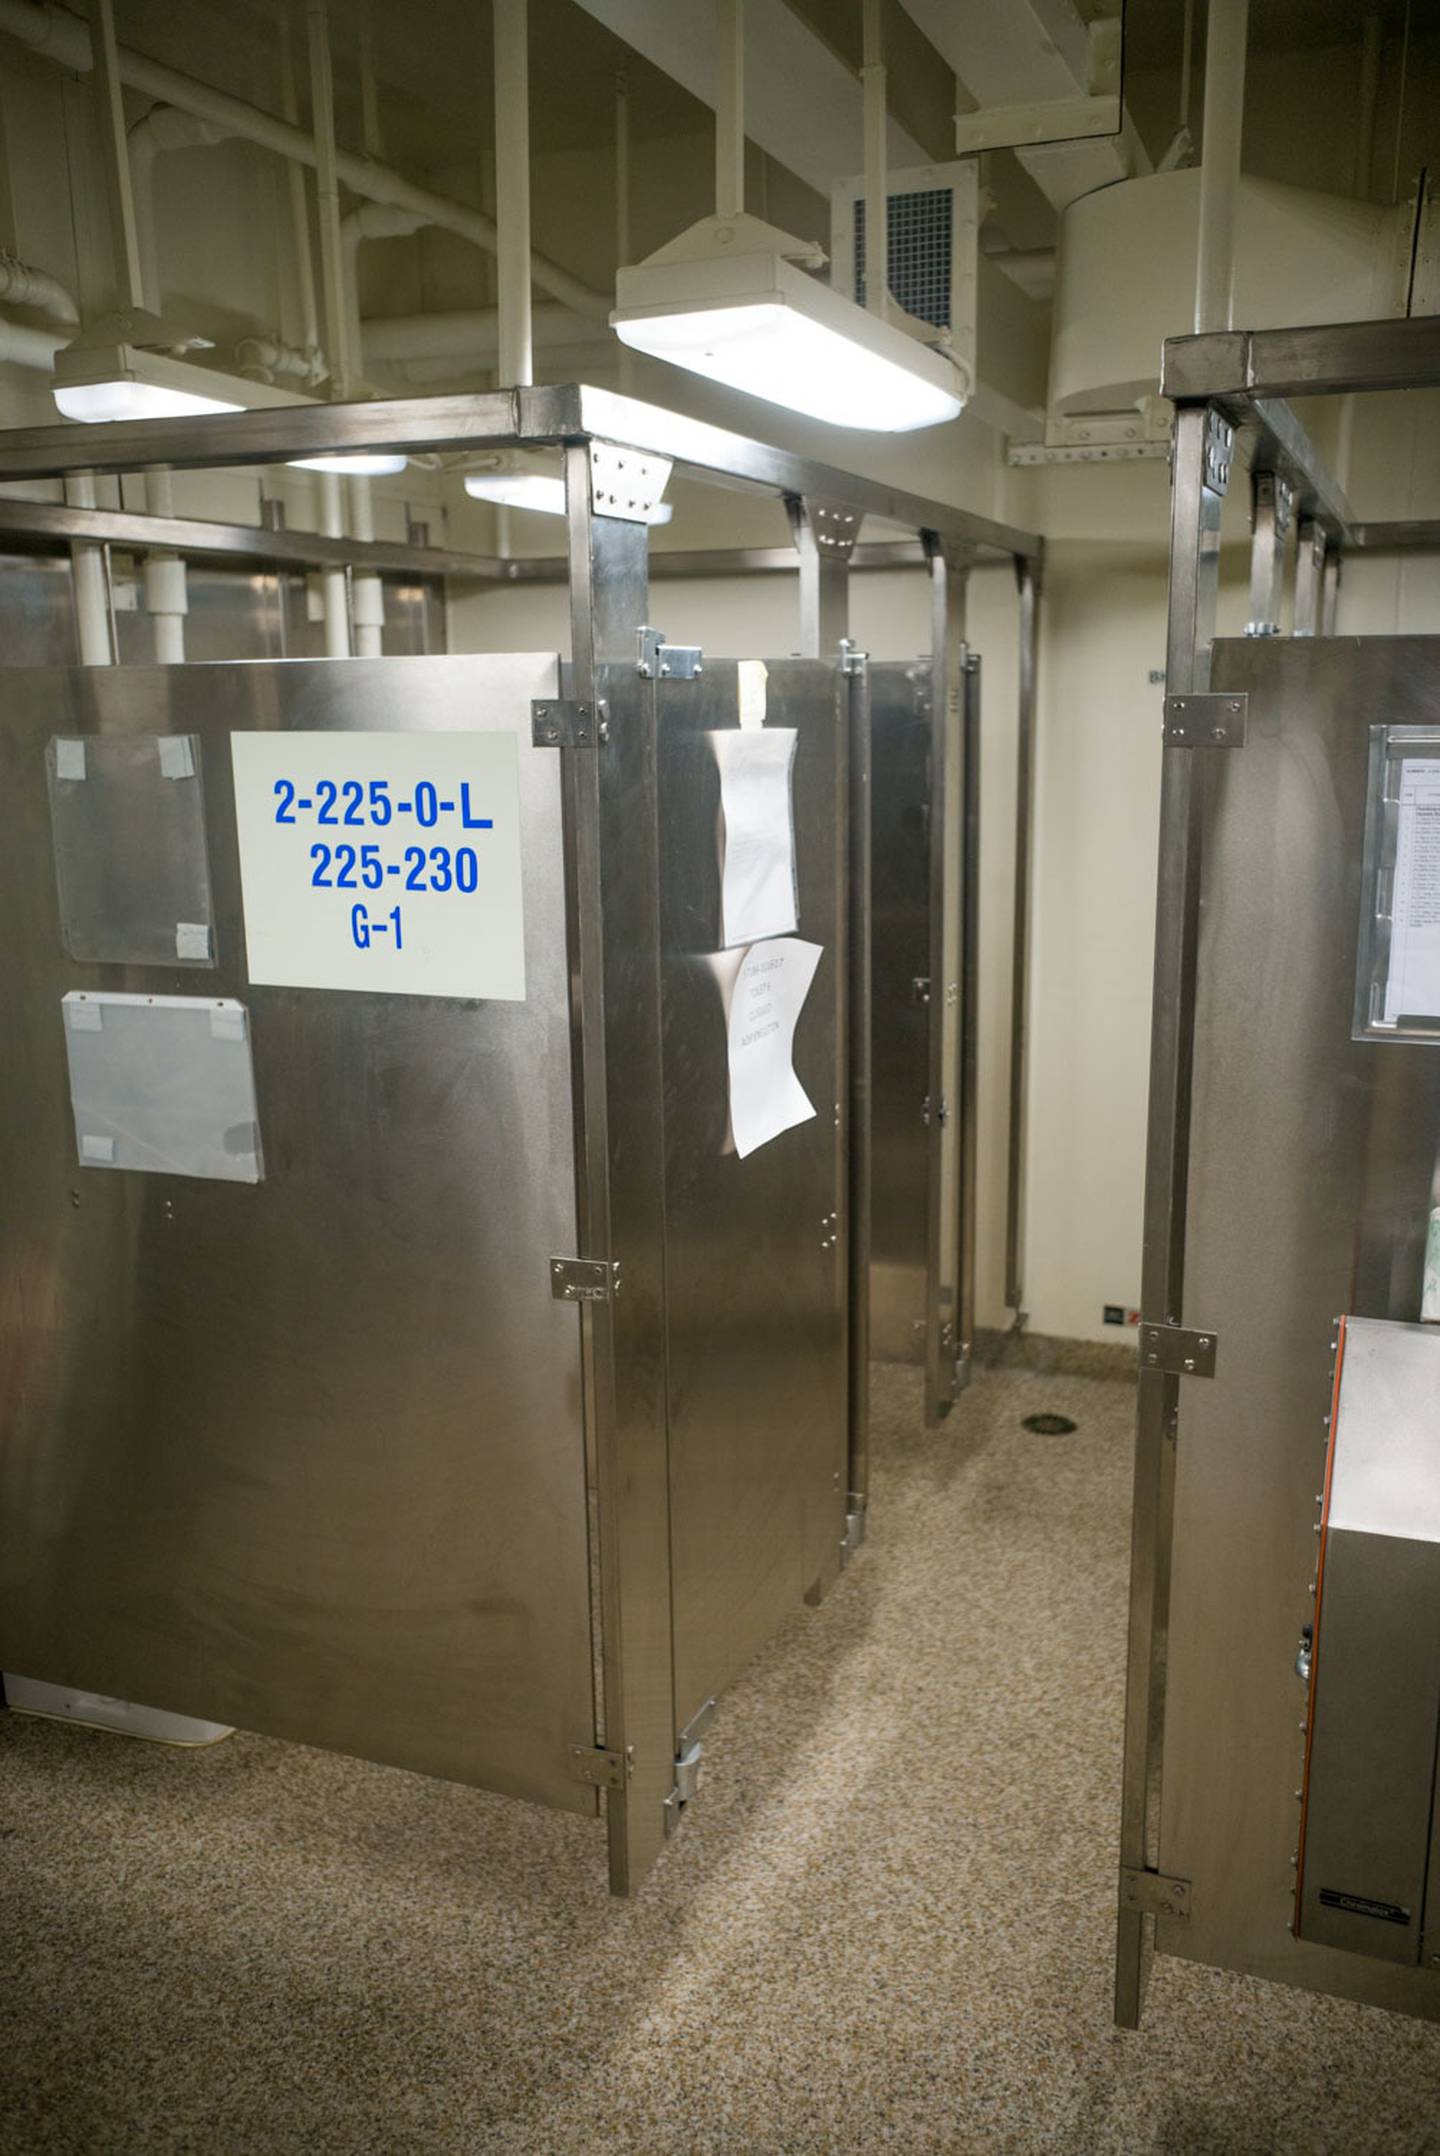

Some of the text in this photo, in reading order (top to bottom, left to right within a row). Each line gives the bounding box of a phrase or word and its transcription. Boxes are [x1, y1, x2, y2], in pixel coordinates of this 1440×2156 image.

[273, 779, 493, 829] 2-225-0-L
[310, 843, 478, 894] 225-230
[351, 903, 403, 950] G-1
